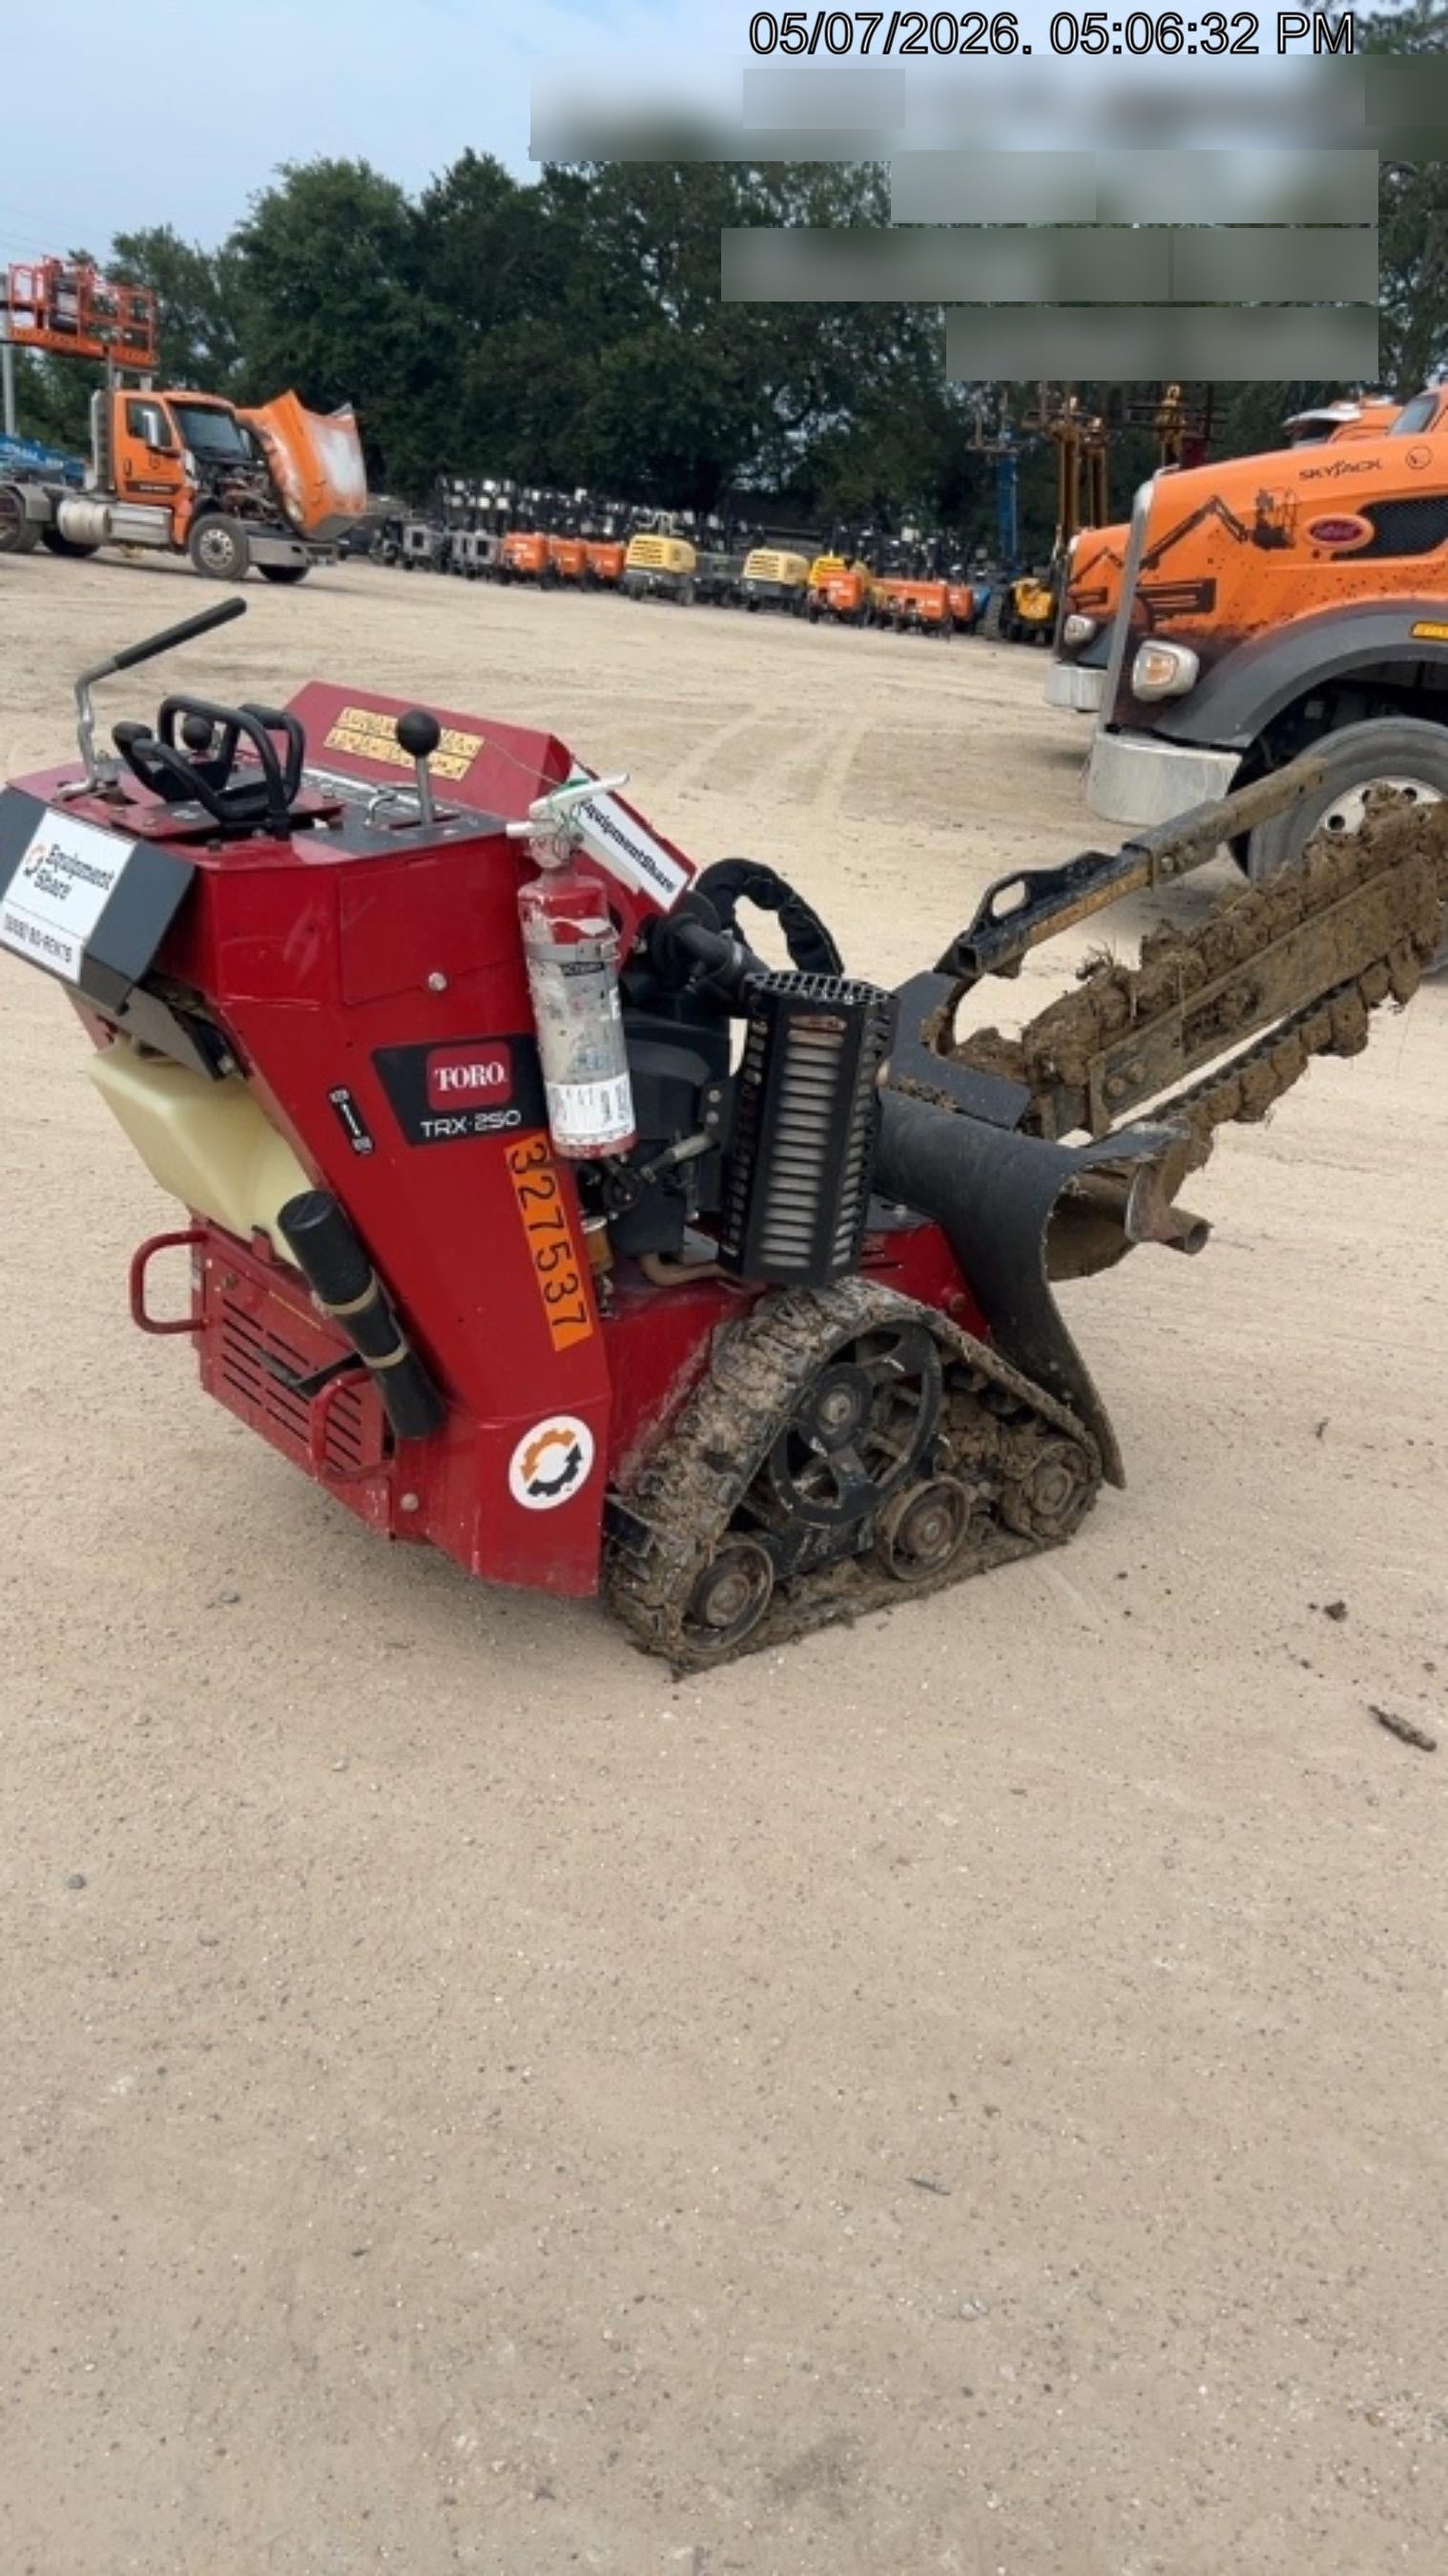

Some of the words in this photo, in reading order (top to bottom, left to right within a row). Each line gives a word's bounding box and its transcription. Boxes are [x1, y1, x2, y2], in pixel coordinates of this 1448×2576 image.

[1298, 459, 1382, 481] SKYJACK
[34, 866, 72, 900] Share
[45, 843, 114, 891] Equipment
[434, 1061, 506, 1091] TORO
[510, 1142, 587, 1326] 327537
